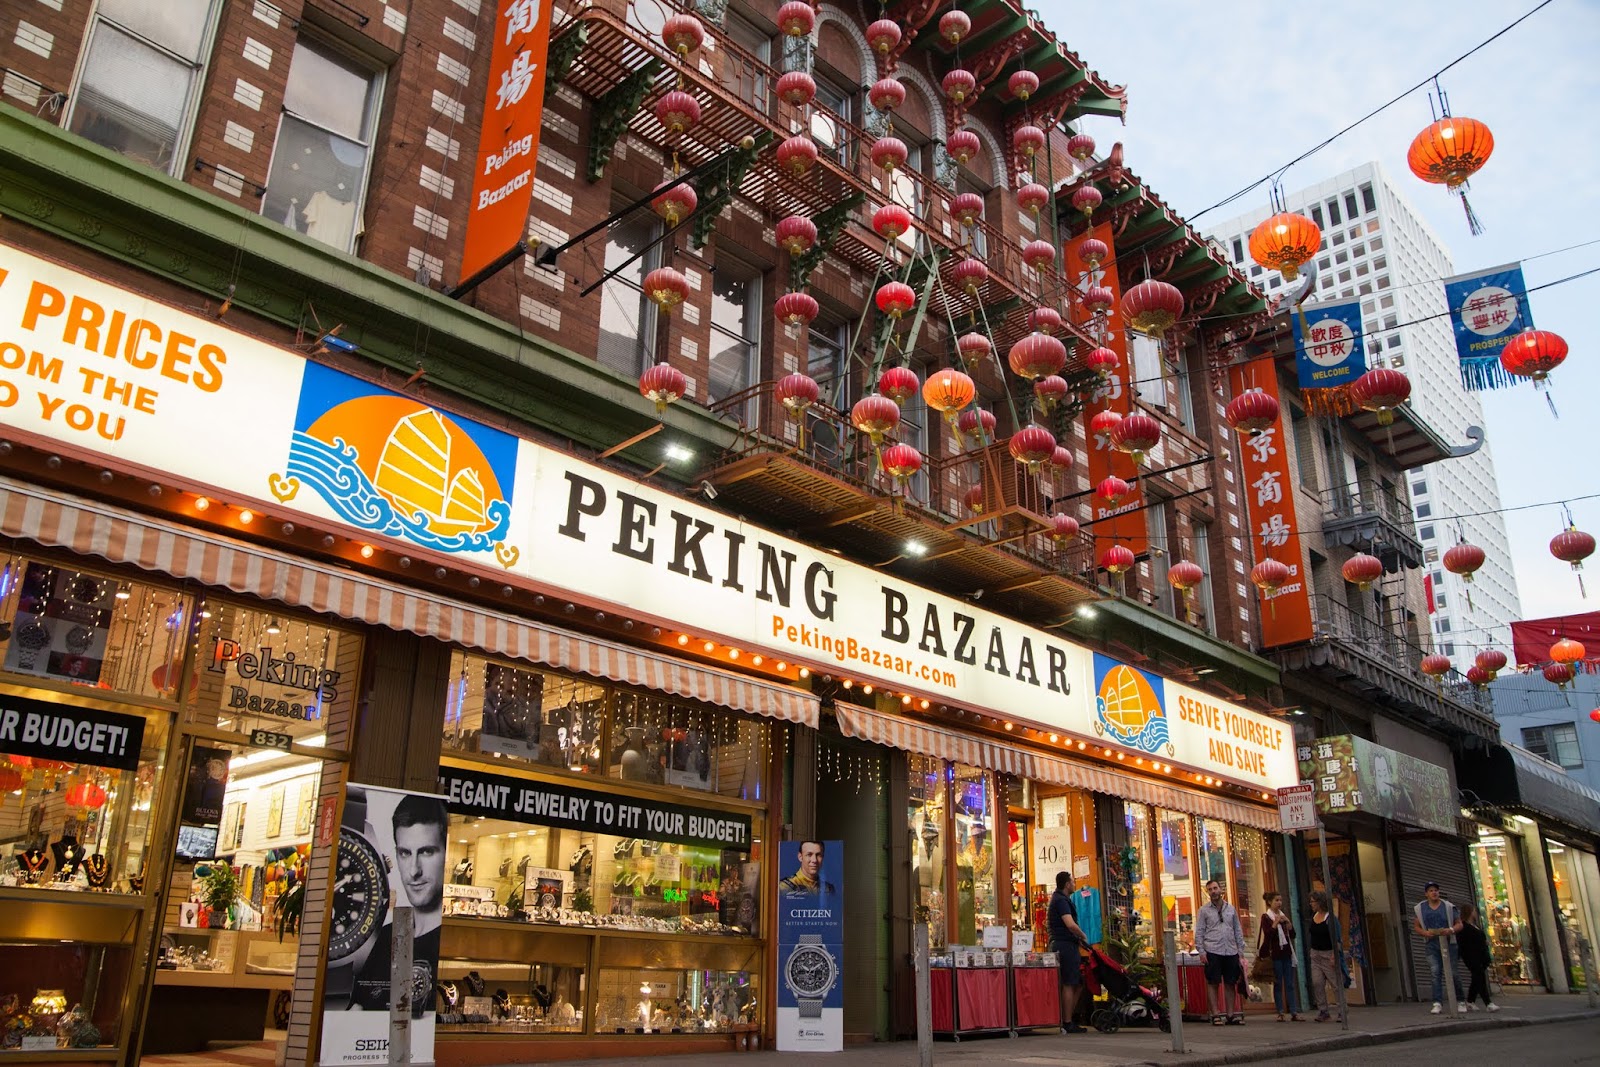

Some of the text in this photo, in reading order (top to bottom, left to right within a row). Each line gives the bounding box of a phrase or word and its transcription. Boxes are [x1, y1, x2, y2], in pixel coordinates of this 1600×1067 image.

[484, 134, 533, 176] Peking
[477, 169, 532, 210] Bazaar
[20, 280, 227, 393] PRICES
[1311, 324, 1344, 342] 歡度
[1313, 341, 1347, 359] 中秋
[1469, 333, 1519, 351] PROSPERI
[79, 367, 159, 415] THE
[1312, 366, 1350, 380] WELCOME
[37, 392, 126, 441] YOU
[558, 470, 1071, 696] PEKING BAZAAR
[208, 636, 341, 703] Peking
[772, 615, 957, 688] PekingBazaar.com
[228, 685, 316, 721] Bazaar
[22, 712, 129, 756] BUDGET!
[254, 731, 288, 749] 832
[1178, 695, 1282, 751] SERVE YOURSELF
[1209, 738, 1267, 777] AND SAVE
[514, 789, 589, 822] JEWELRY
[594, 801, 614, 825] TO
[618, 805, 642, 829] FIT
[645, 809, 684, 836] YOUR
[688, 815, 746, 843] BUDGET!
[1279, 793, 1312, 805] NO STOPPING
[1290, 804, 1304, 813] ANY
[1038, 844, 1058, 864] 40
[454, 887, 480, 896] BULOVA
[790, 909, 832, 918] CITIZEN
[355, 1039, 390, 1051] SEIK
